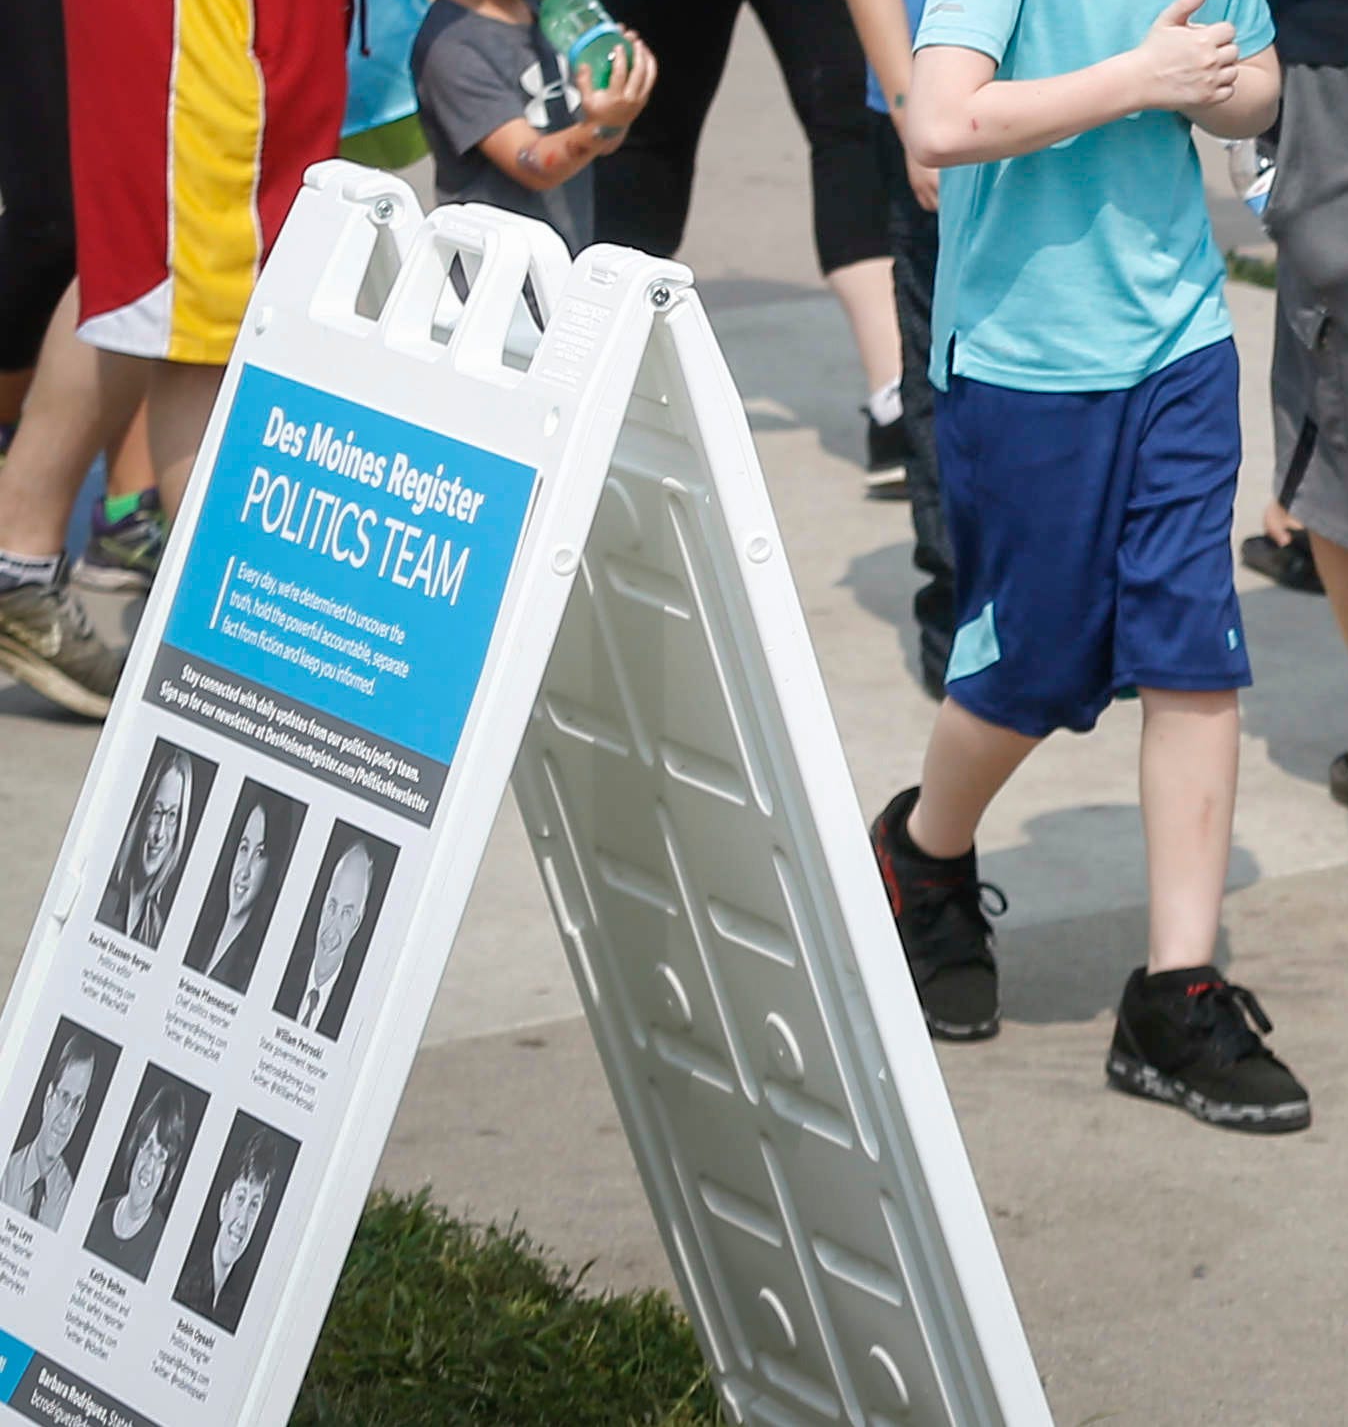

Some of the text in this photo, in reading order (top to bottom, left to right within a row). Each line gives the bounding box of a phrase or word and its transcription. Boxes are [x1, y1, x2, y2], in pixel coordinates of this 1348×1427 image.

[263, 407, 483, 522] Des Moines Register
[242, 468, 469, 604] POLITICS TEAM
[237, 561, 262, 589] Every
[260, 571, 278, 596] day,
[299, 588, 349, 621] determined
[346, 608, 357, 626] to
[356, 615, 391, 638] uncover
[389, 624, 405, 645] the
[252, 597, 274, 621] hold
[271, 607, 287, 627] the
[284, 616, 324, 641] powerful
[321, 631, 371, 666] accountable,
[372, 652, 409, 678] separate
[221, 615, 376, 696] fact from fiction and keep you informed.
[160, 680, 179, 703] Sign
[177, 691, 190, 709] up
[188, 692, 203, 711] for
[201, 701, 217, 717] our
[214, 708, 257, 735] newsletter
[255, 725, 267, 741] at
[181, 664, 201, 688] Stay
[199, 676, 242, 702] connected
[239, 690, 258, 710] with
[256, 697, 278, 722] daily
[276, 709, 309, 733] updates
[307, 718, 328, 741] from
[327, 731, 343, 747] our
[39, 1368, 68, 1398] Barbara
